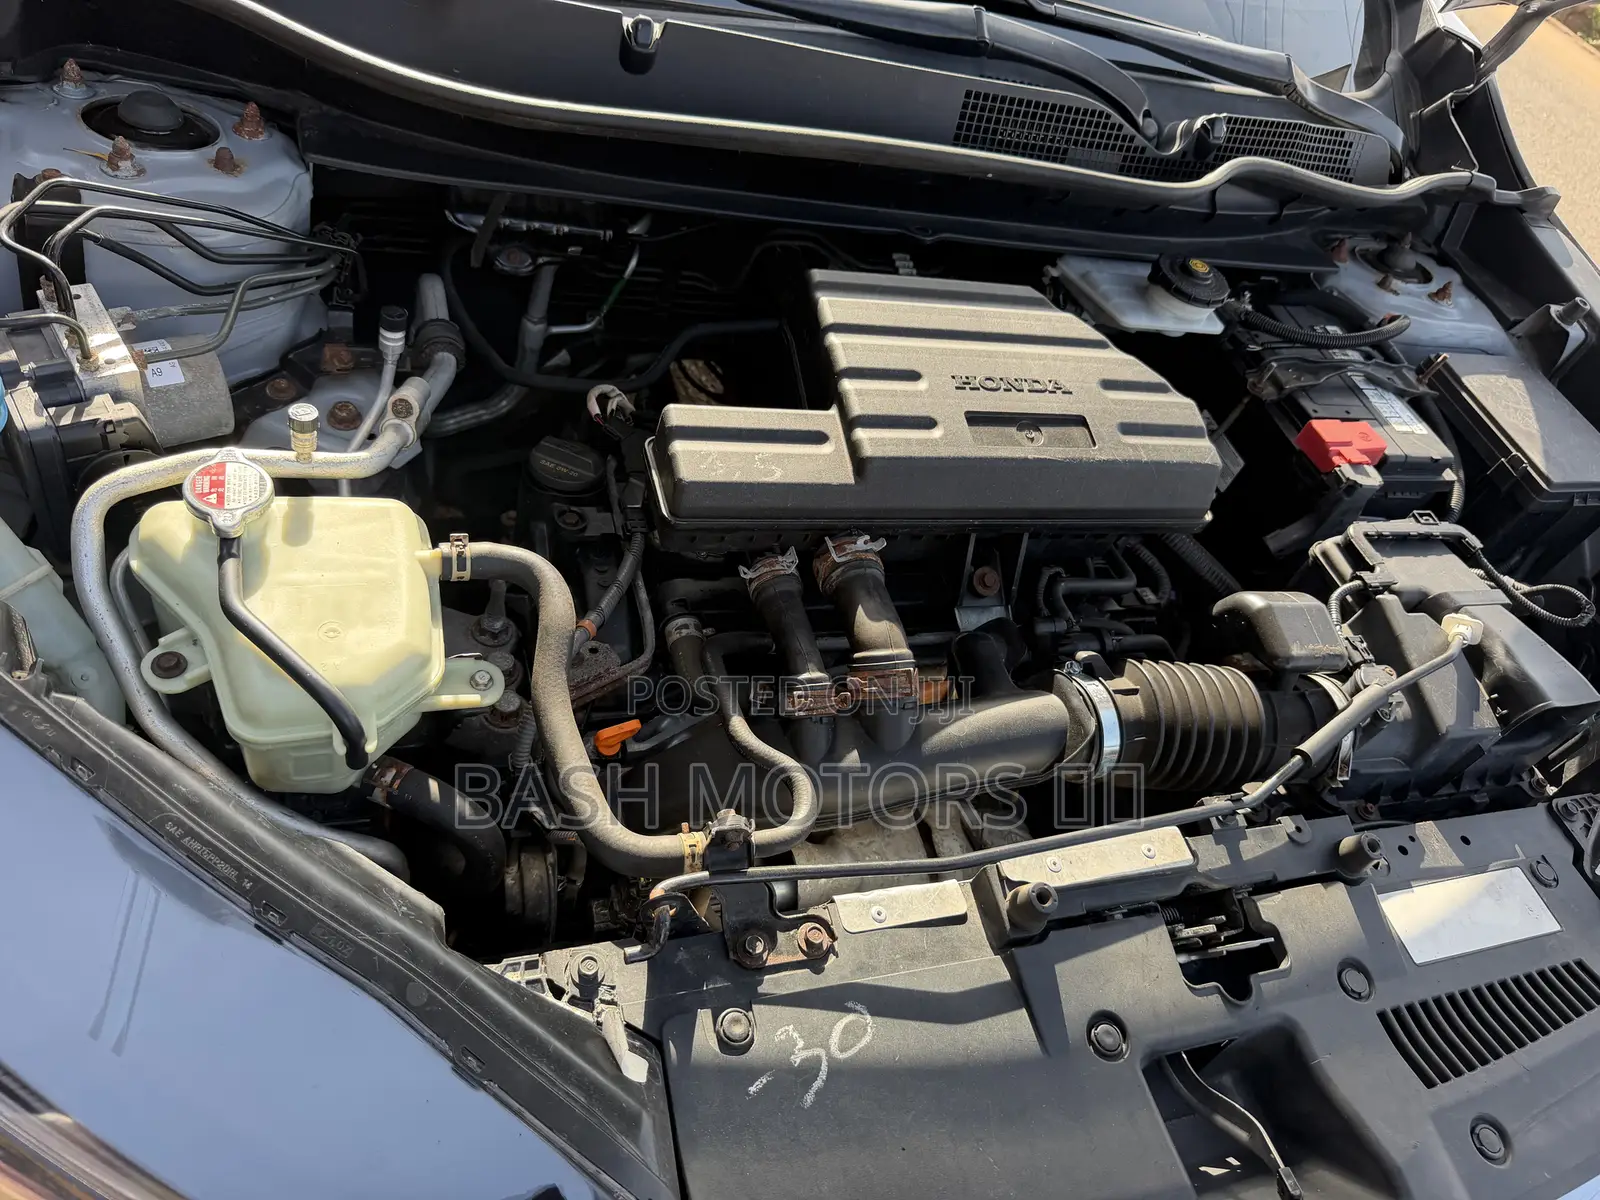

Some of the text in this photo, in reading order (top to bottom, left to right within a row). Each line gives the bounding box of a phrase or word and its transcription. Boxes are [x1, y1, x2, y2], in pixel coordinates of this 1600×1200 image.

[151, 367, 163, 378] A9
[950, 374, 1073, 395] HONDA
[164, 821, 185, 838] SAE
